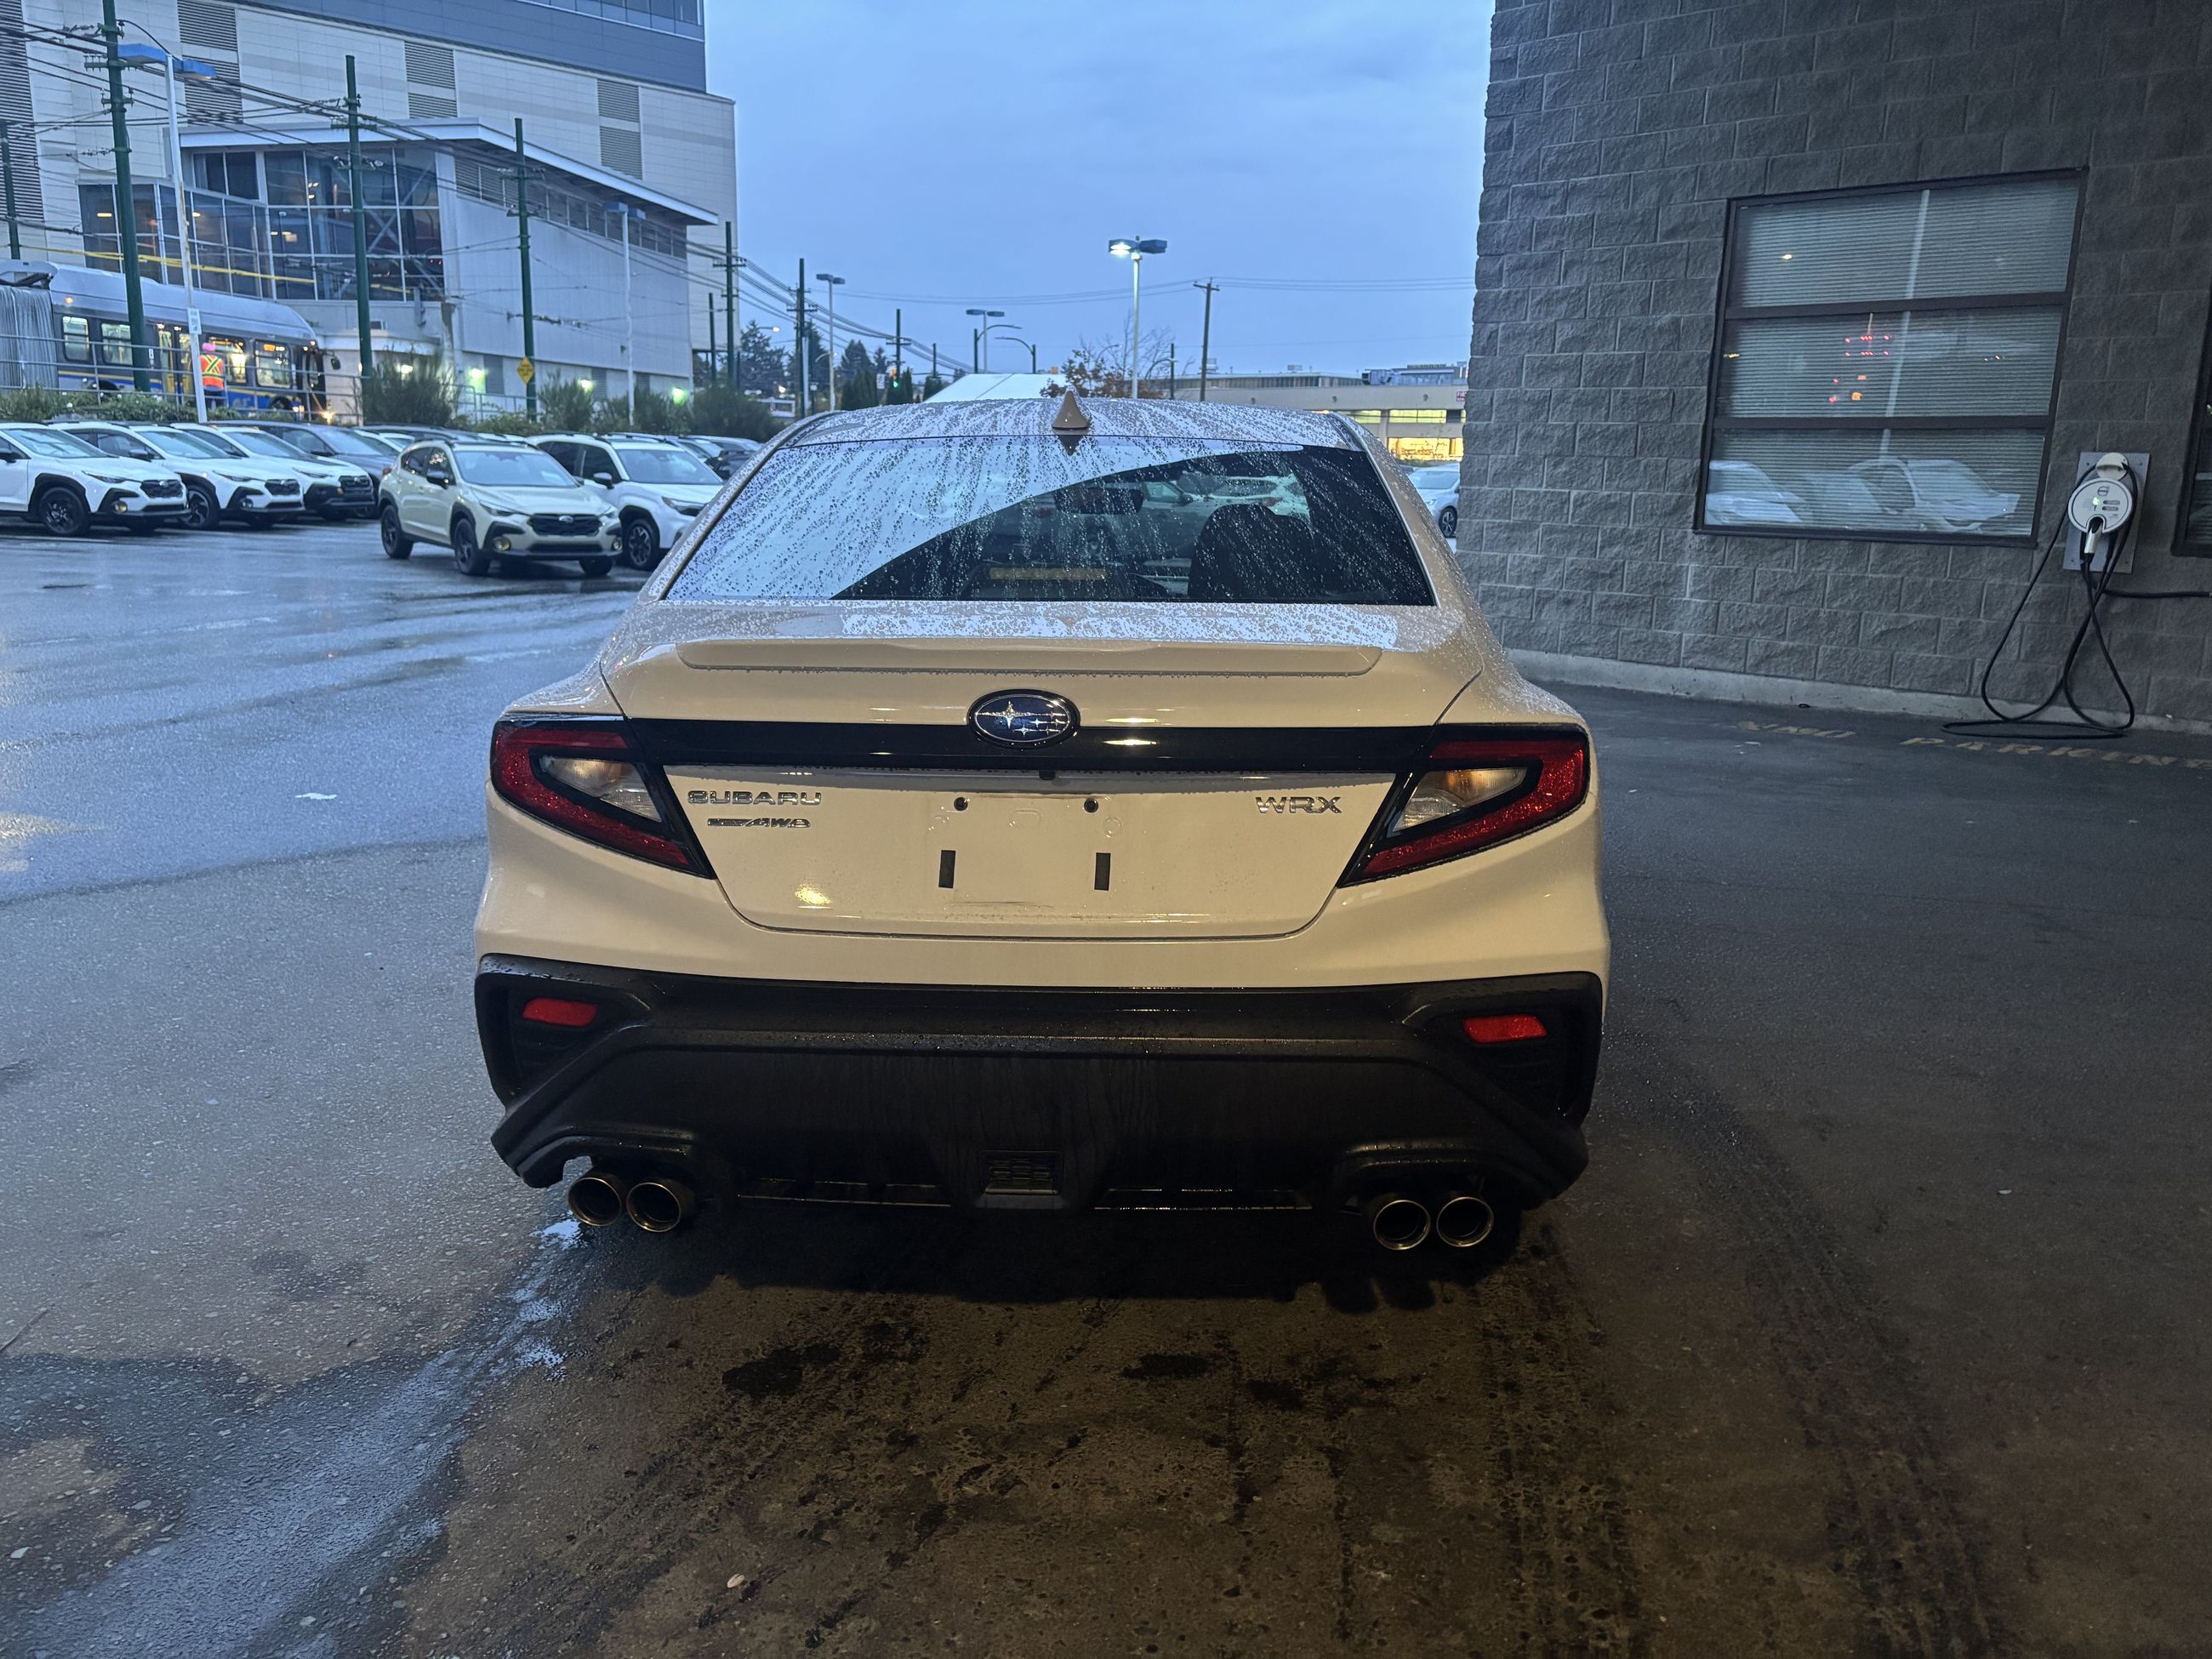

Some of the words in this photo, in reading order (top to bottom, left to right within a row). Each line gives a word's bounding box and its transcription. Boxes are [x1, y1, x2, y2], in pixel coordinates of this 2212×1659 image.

[687, 790, 822, 806] SUBARU
[1255, 796, 1343, 813] WRX
[744, 818, 811, 828] AWD
